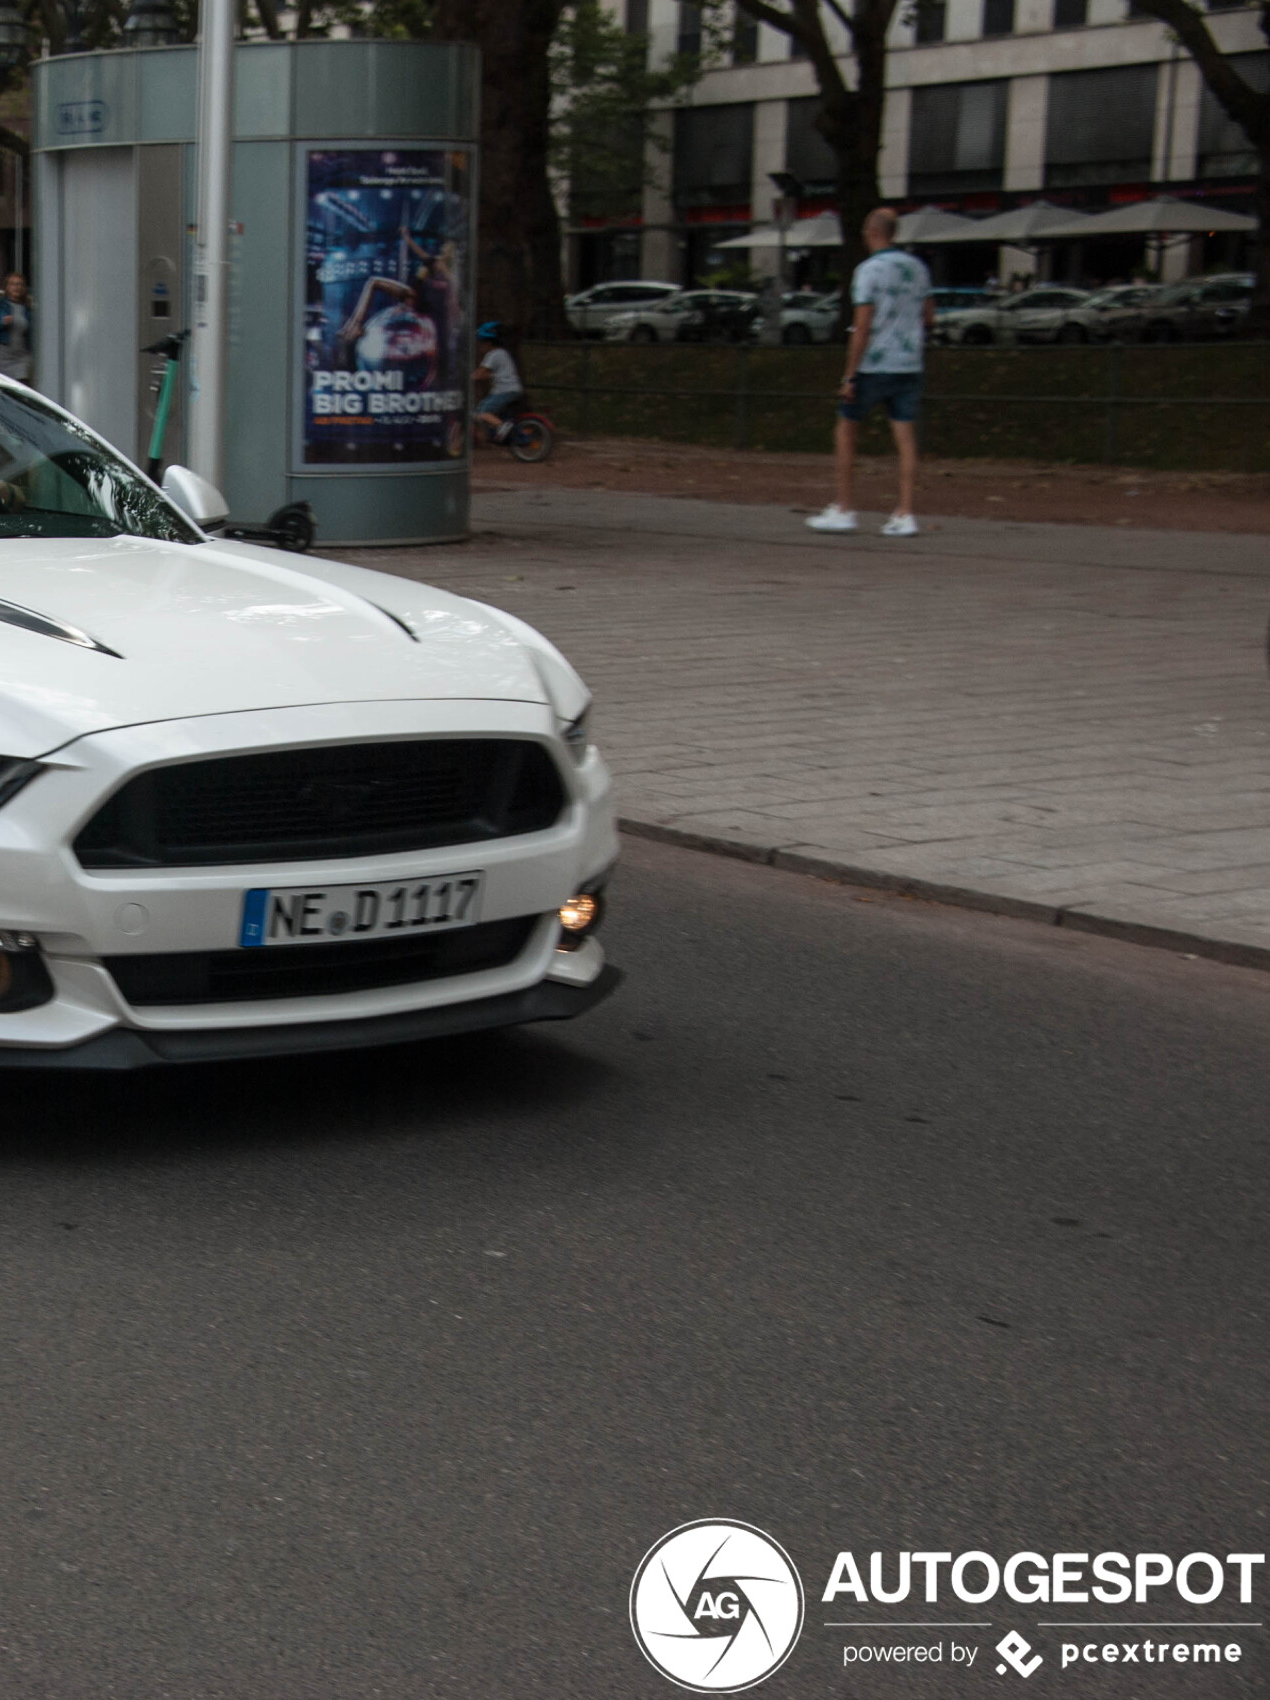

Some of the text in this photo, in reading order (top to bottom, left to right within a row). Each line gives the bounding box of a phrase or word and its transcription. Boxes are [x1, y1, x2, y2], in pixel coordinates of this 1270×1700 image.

[314, 370, 404, 391] PROMI
[313, 392, 363, 414] BIG
[269, 893, 327, 938] NE
